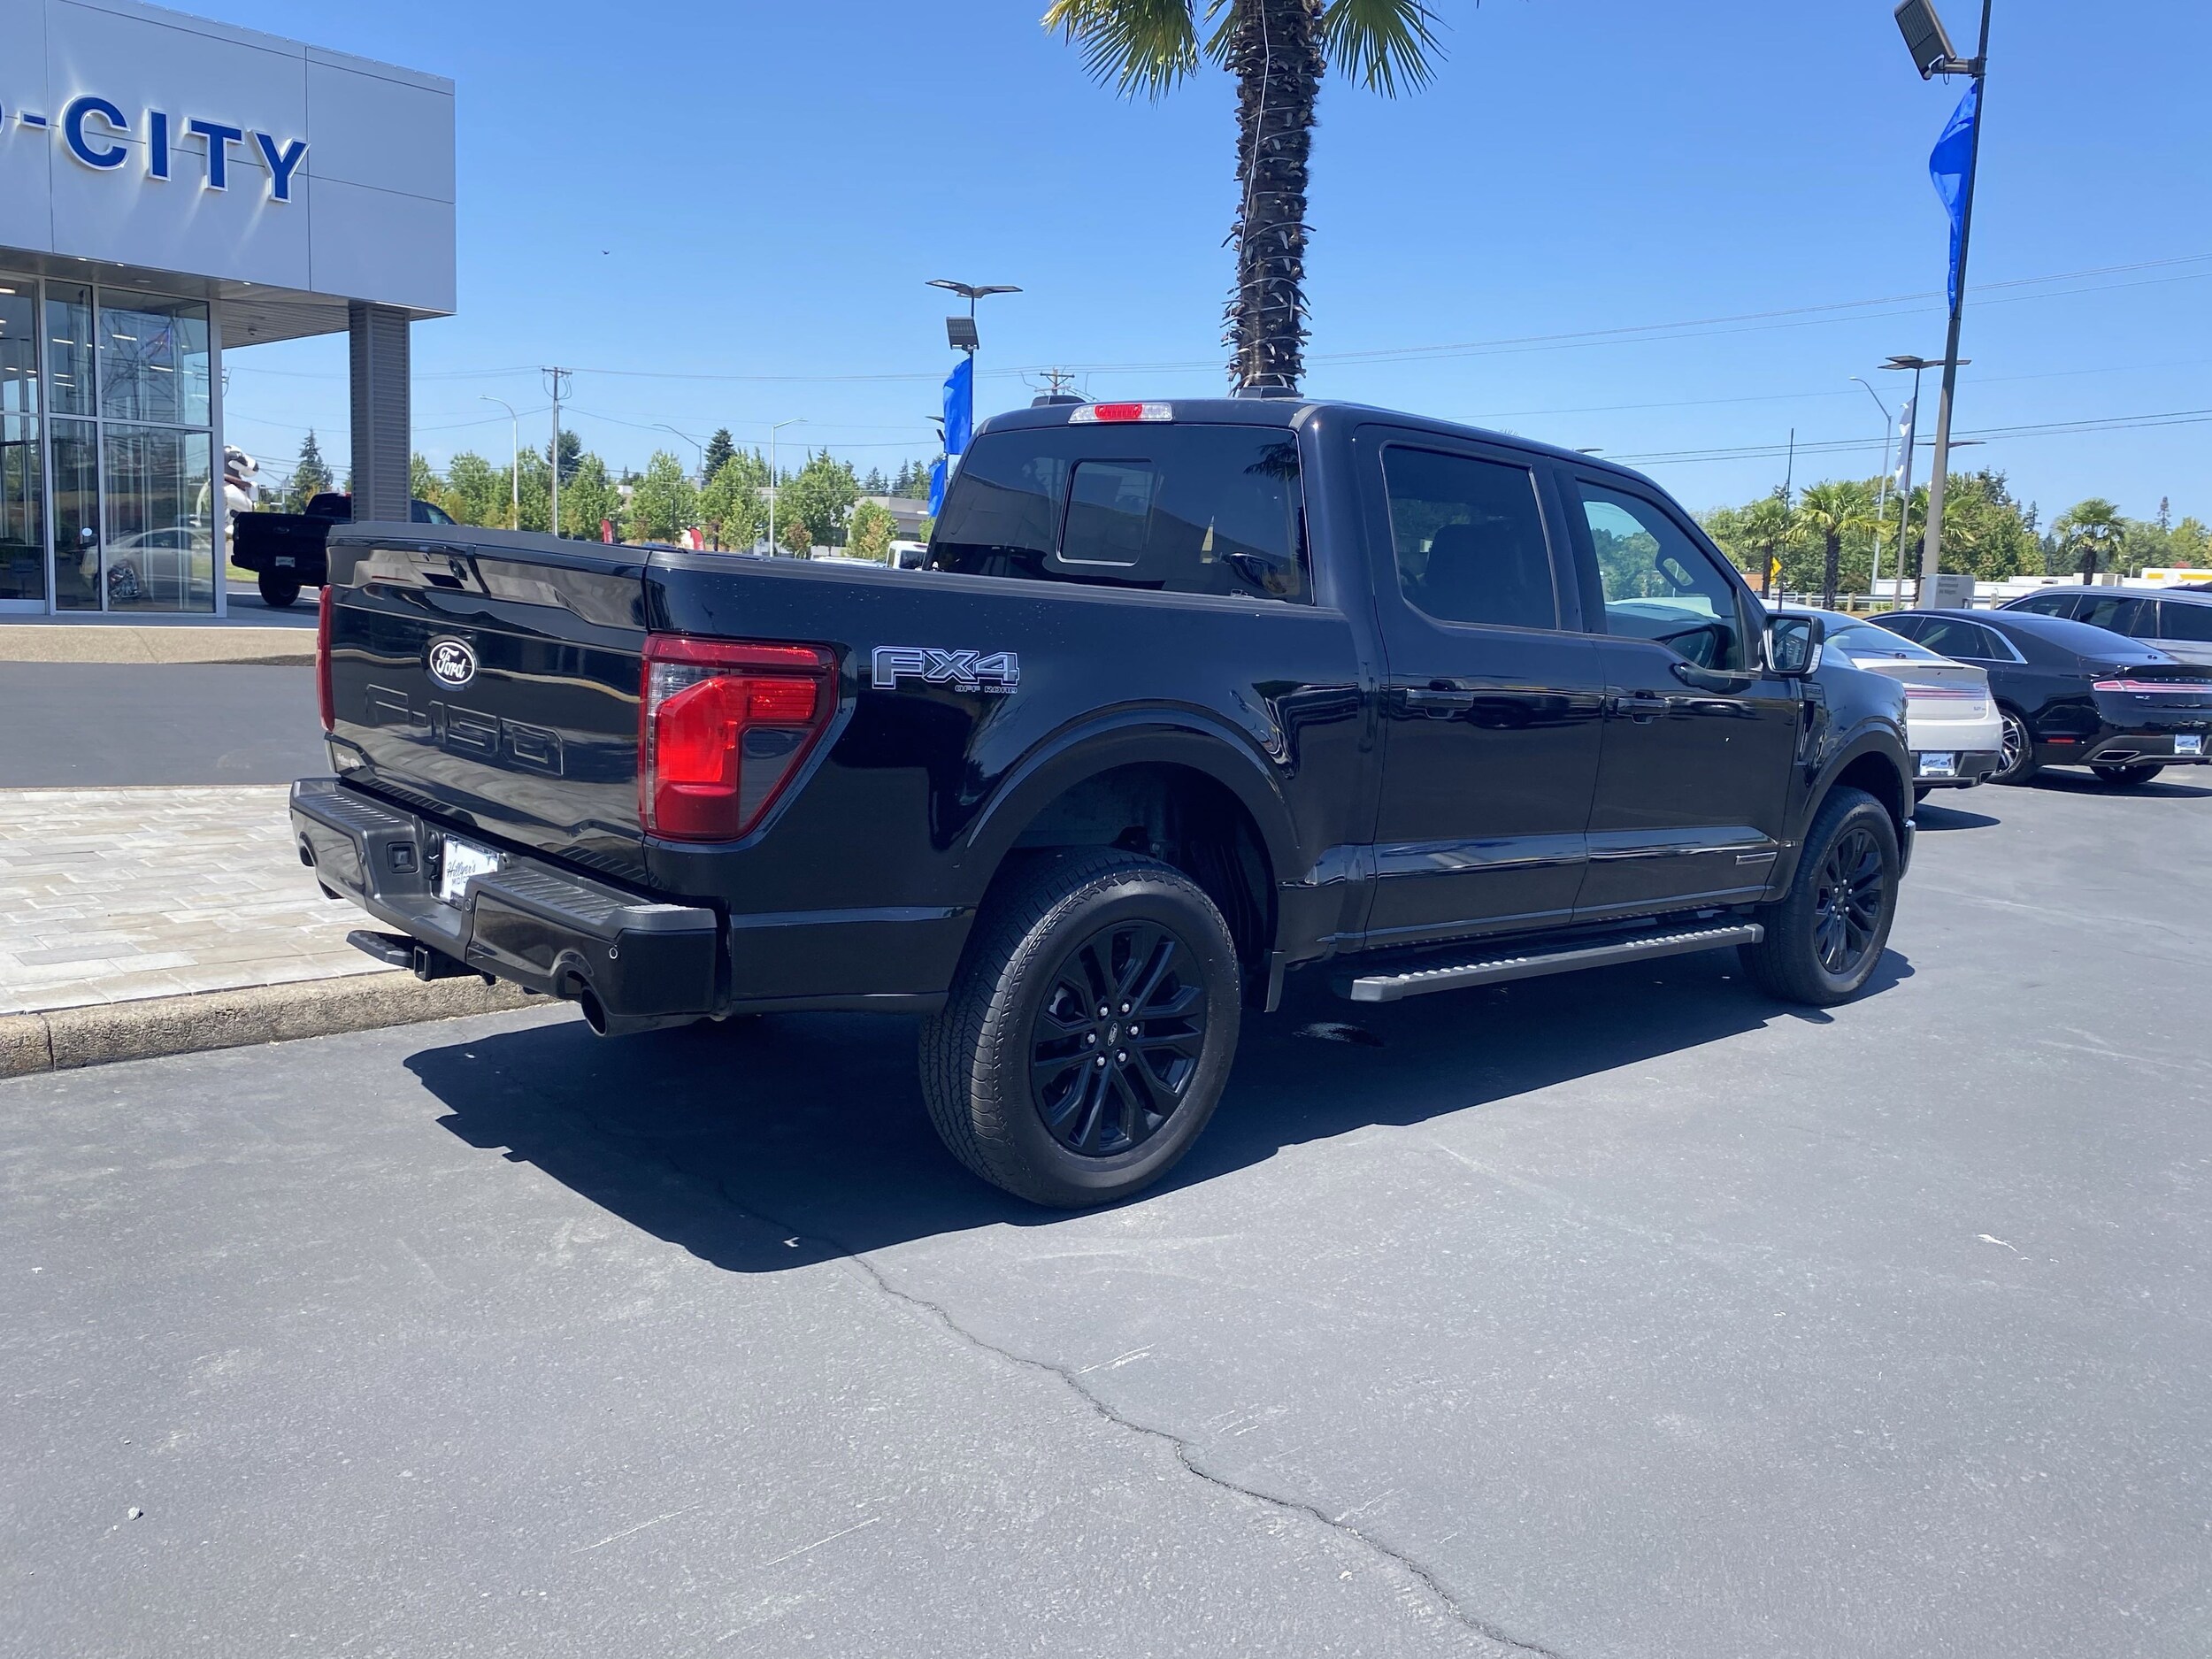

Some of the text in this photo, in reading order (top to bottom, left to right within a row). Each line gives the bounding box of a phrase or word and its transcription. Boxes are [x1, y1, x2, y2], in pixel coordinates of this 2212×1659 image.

[0, 94, 311, 204] -CITY
[436, 647, 466, 679] Ford
[872, 645, 1020, 690] FX4
